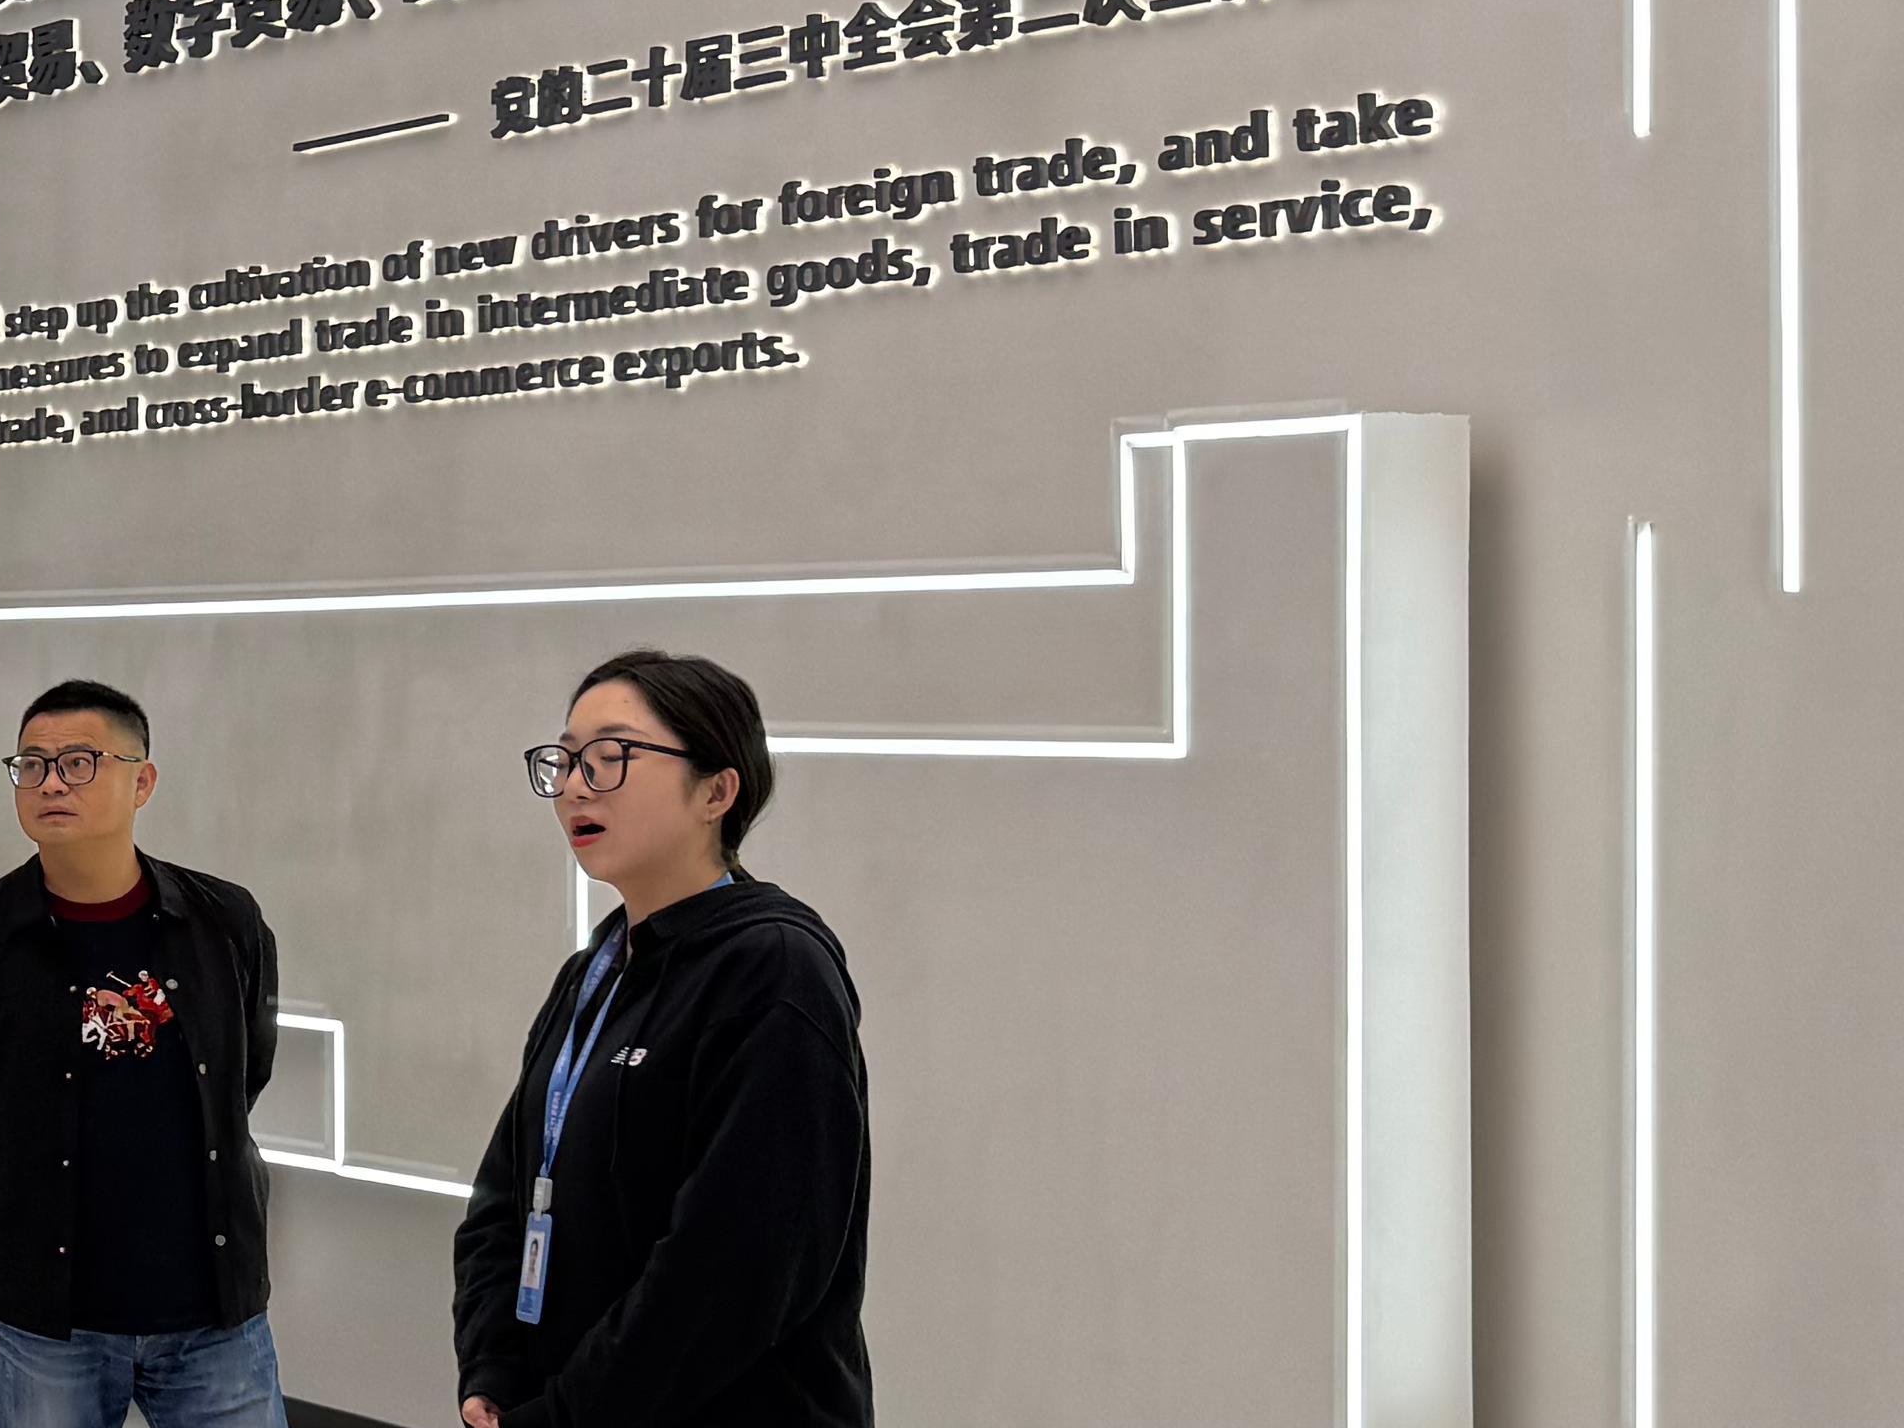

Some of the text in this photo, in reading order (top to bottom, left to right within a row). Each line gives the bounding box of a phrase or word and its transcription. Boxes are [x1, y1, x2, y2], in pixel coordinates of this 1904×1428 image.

[4, 305, 69, 340] step
[77, 297, 118, 333] up
[126, 283, 179, 320] the
[188, 256, 371, 310] cultivation
[382, 240, 425, 281] of
[434, 235, 518, 276] new
[531, 214, 680, 261] drivers
[696, 194, 763, 238] for
[778, 167, 955, 226] foreign
[973, 138, 1137, 197] trade,
[1158, 109, 1269, 172] and
[1293, 92, 1434, 152] take
[135, 344, 169, 374] to
[177, 318, 303, 373] expand
[314, 307, 414, 352] trade
[425, 299, 465, 339] in
[477, 268, 750, 333] intermediate
[766, 238, 931, 307] goods,
[950, 216, 1092, 274] trade
[1114, 207, 1170, 255] in
[1193, 179, 1433, 245] service,
[80, 397, 139, 436] and
[145, 376, 359, 429] cross-border
[364, 353, 605, 408] e-commerce
[613, 332, 799, 389] exports.
